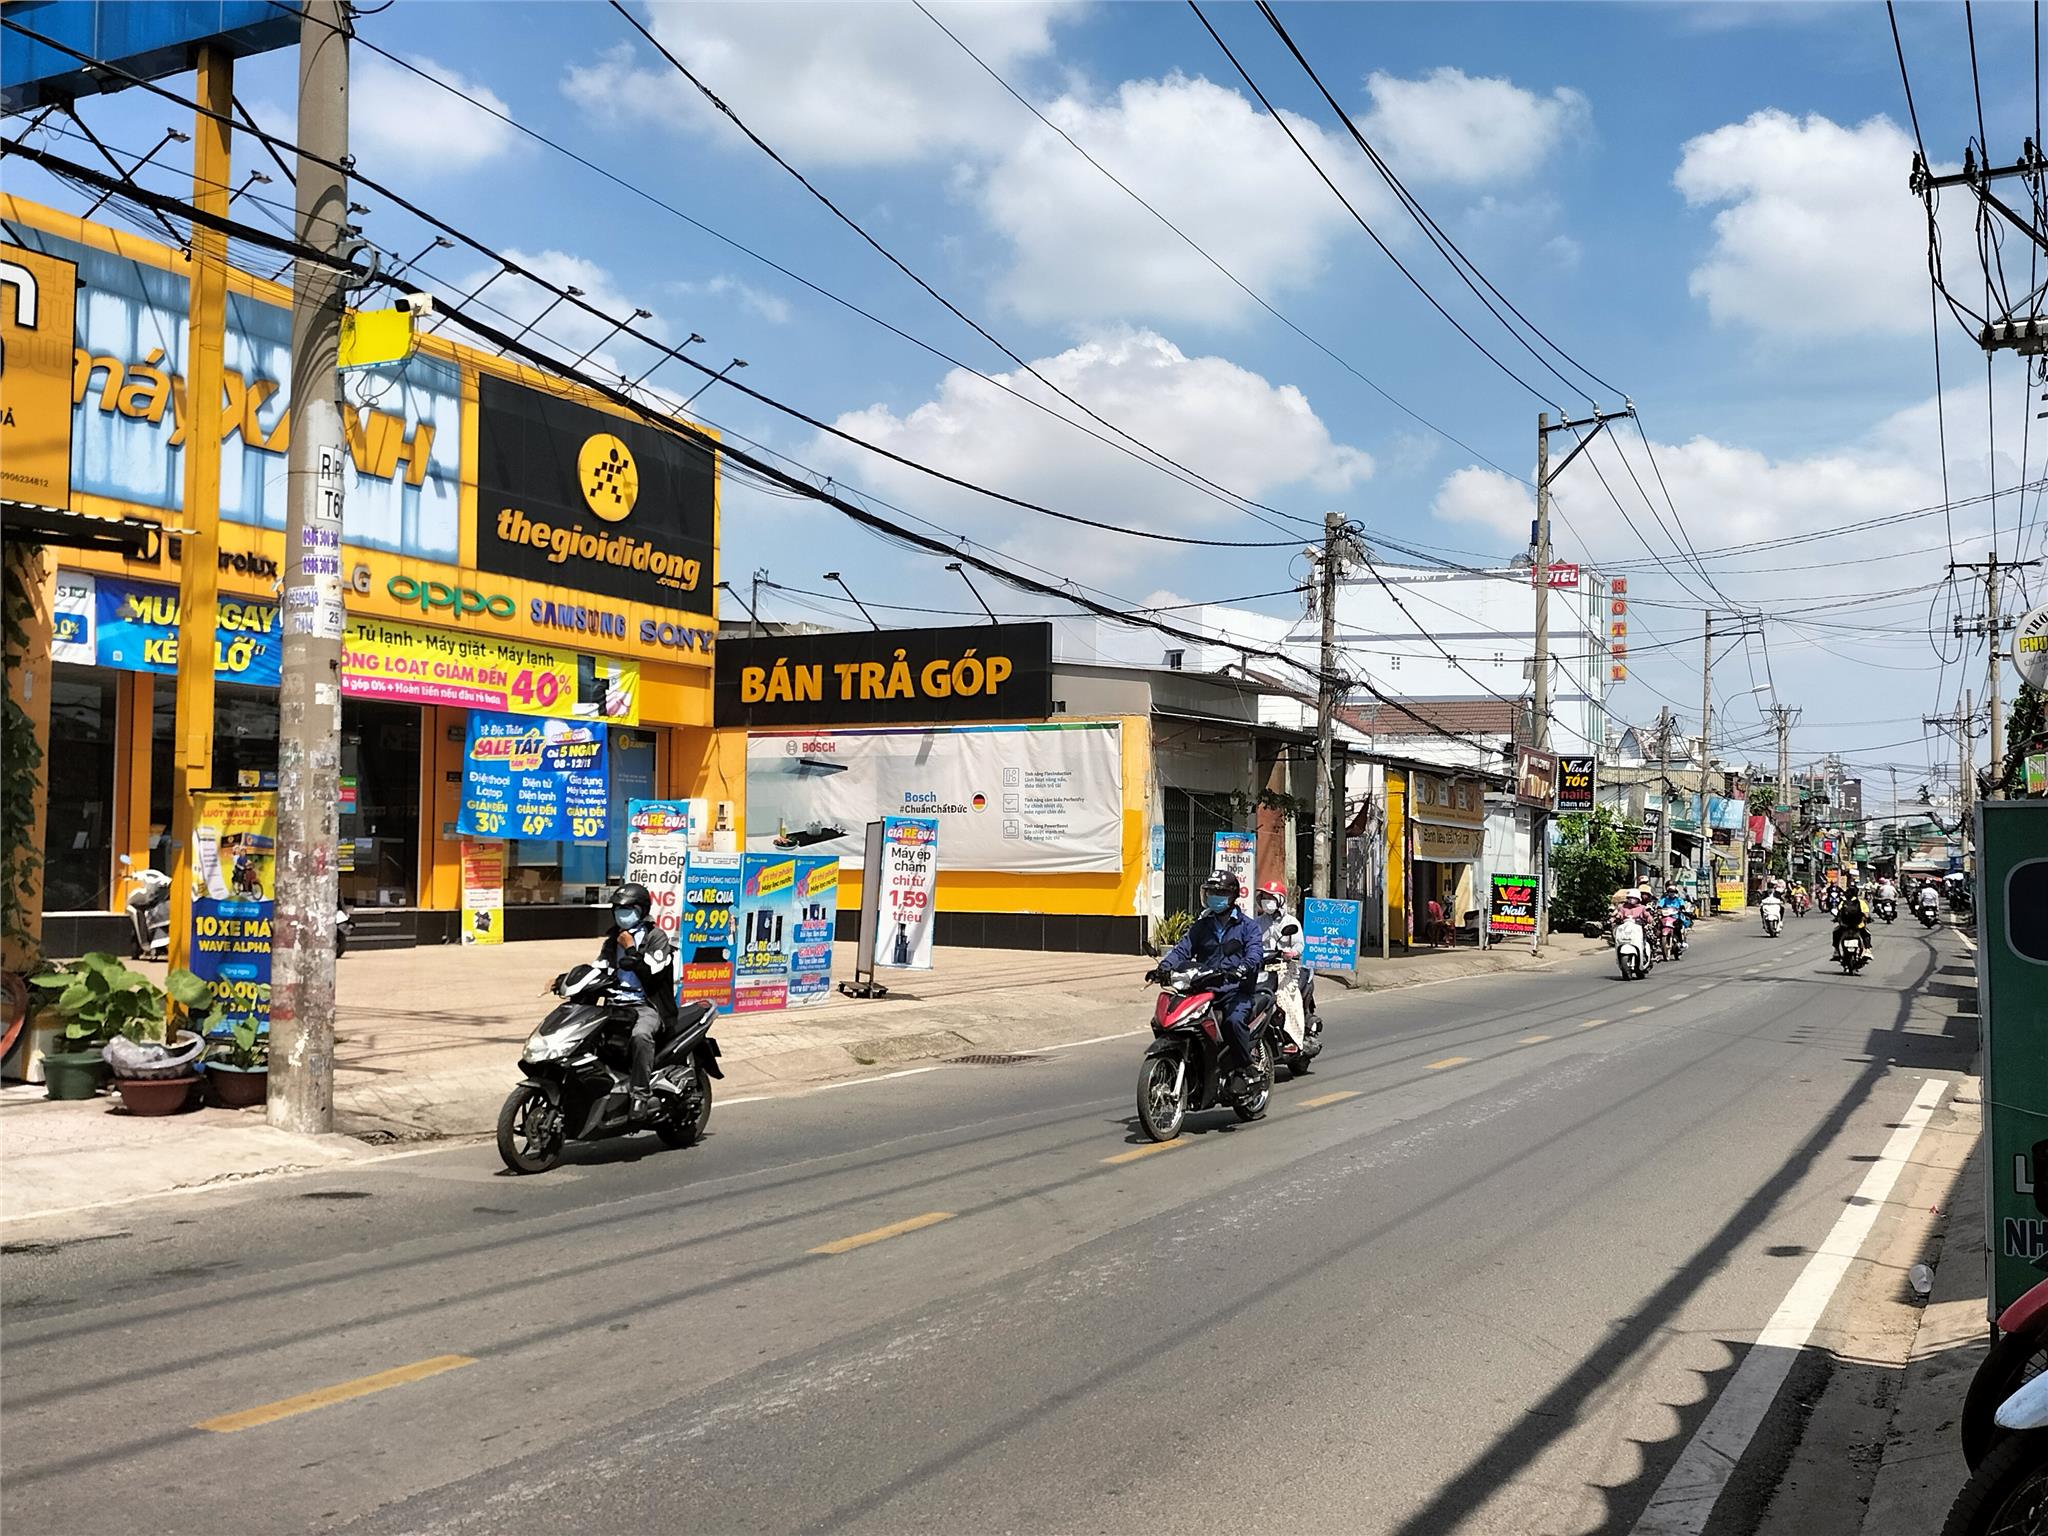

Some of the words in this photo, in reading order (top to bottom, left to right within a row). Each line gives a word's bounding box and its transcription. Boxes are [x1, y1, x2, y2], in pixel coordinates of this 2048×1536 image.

[322, 453, 331, 480] R
[325, 490, 343, 519] T6
[496, 508, 700, 591] thegioididong
[215, 602, 280, 633] GAY
[329, 611, 339, 624] 25
[530, 598, 625, 638] SAMSUNG
[640, 620, 713, 652] SONY
[144, 633, 179, 663] KẺ
[357, 624, 375, 642] Tủ
[380, 627, 413, 648] lạnh
[425, 635, 455, 656] Máy
[459, 640, 486, 660] giặt
[498, 645, 523, 666] Máy
[527, 649, 554, 668] lạnh
[341, 644, 379, 670] ỒNG
[385, 657, 429, 679] LOẠT
[433, 660, 474, 683] GIẢM
[478, 664, 508, 687] ĐẾN
[511, 669, 571, 707] 40%
[741, 657, 822, 703] BÁN
[834, 648, 915, 700] TRẢ
[921, 649, 1012, 697] GÓP
[475, 740, 512, 755] SALE
[559, 745, 568, 758] 5
[802, 742, 836, 752] BOSCH
[1565, 773, 1589, 787] TÓC
[905, 791, 937, 803] Bosch
[1561, 789, 1591, 800] nails
[900, 803, 967, 813] #ChuẩnChấtĐức
[659, 851, 686, 868] bếp
[891, 845, 915, 860] Máy
[917, 847, 931, 862] ép
[1221, 854, 1236, 863] Hút
[659, 868, 682, 884] đôi
[889, 889, 928, 909] 1,59
[892, 910, 922, 924] triệu
[1500, 905, 1527, 915] Nail
[196, 916, 217, 936] 10
[218, 920, 241, 936] XE
[244, 918, 273, 937] MÁ
[694, 909, 729, 931] 9,99
[1323, 926, 1339, 935] 12K
[198, 940, 231, 952] WAVE
[232, 942, 271, 953] ALPHA
